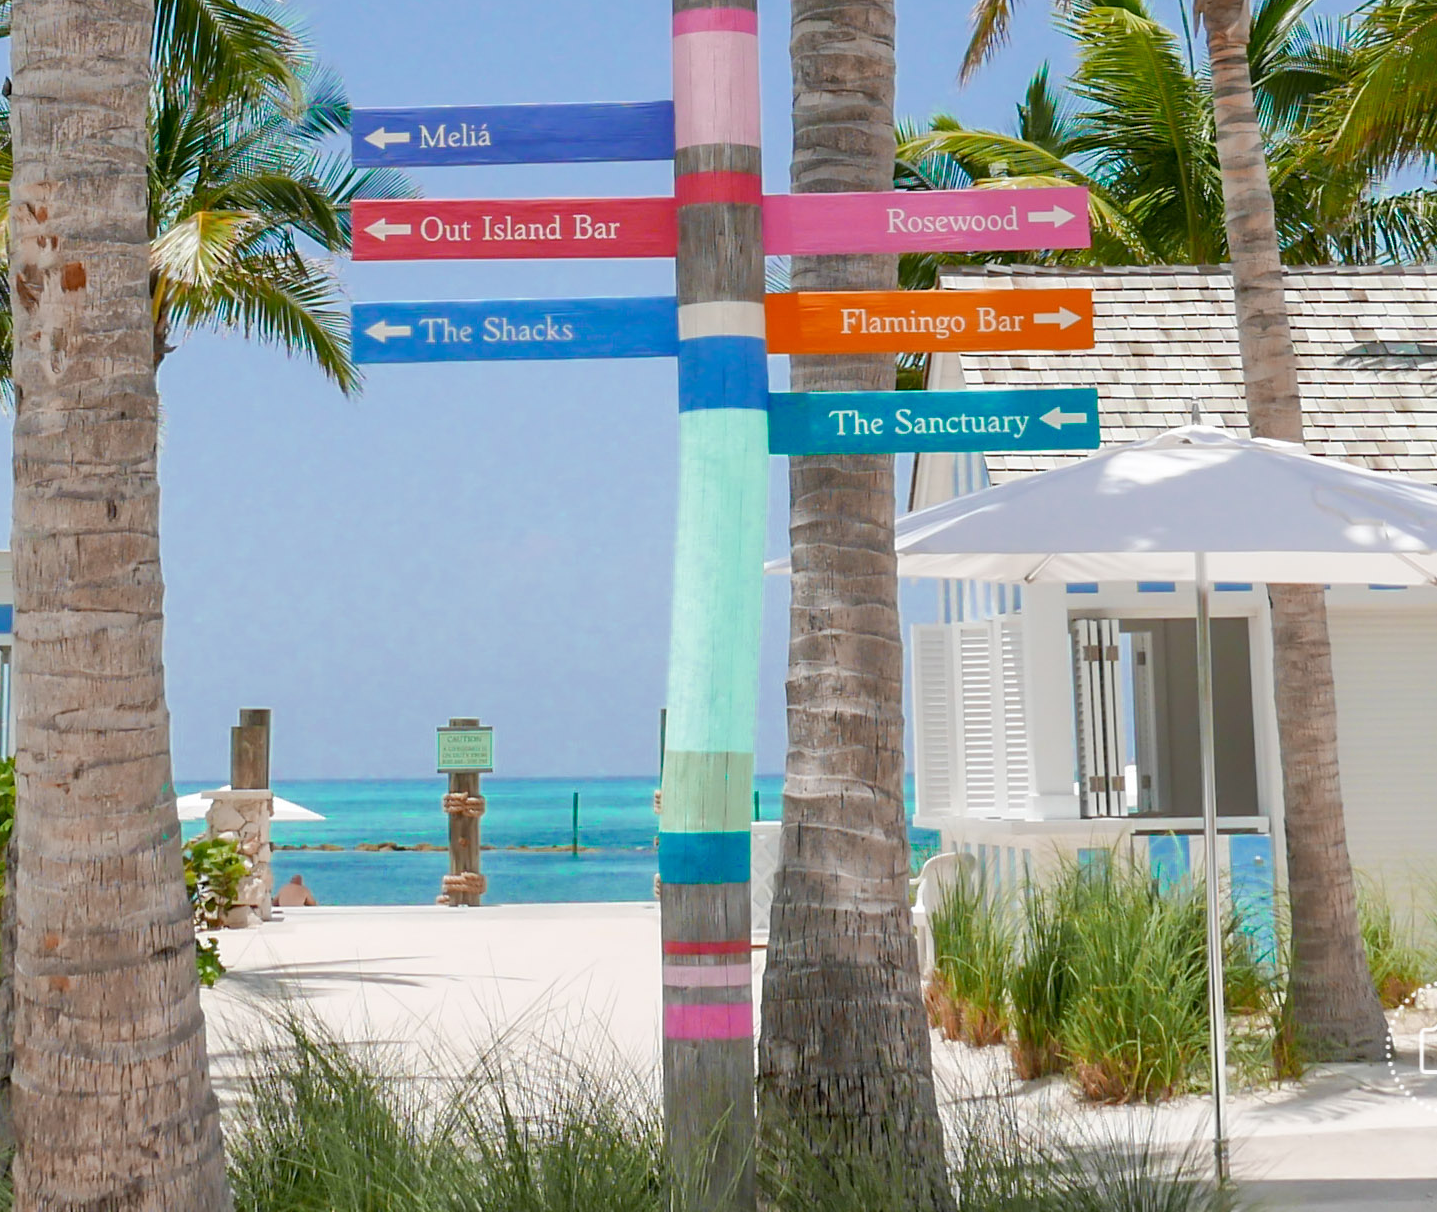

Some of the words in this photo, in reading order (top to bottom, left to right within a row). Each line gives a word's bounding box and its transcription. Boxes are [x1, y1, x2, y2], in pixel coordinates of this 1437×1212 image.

[418, 123, 492, 149] Meliá
[419, 216, 472, 242] Out
[481, 215, 562, 241] Island
[572, 214, 621, 240] Bar
[886, 206, 1020, 234] Rosewood
[418, 317, 473, 344] The
[482, 314, 574, 343] Shacks
[840, 308, 966, 339] Flamingo
[976, 307, 1024, 333] Bar
[828, 409, 884, 436] The
[894, 408, 1030, 439] Sanctuary
[447, 735, 482, 743] CAUTION
